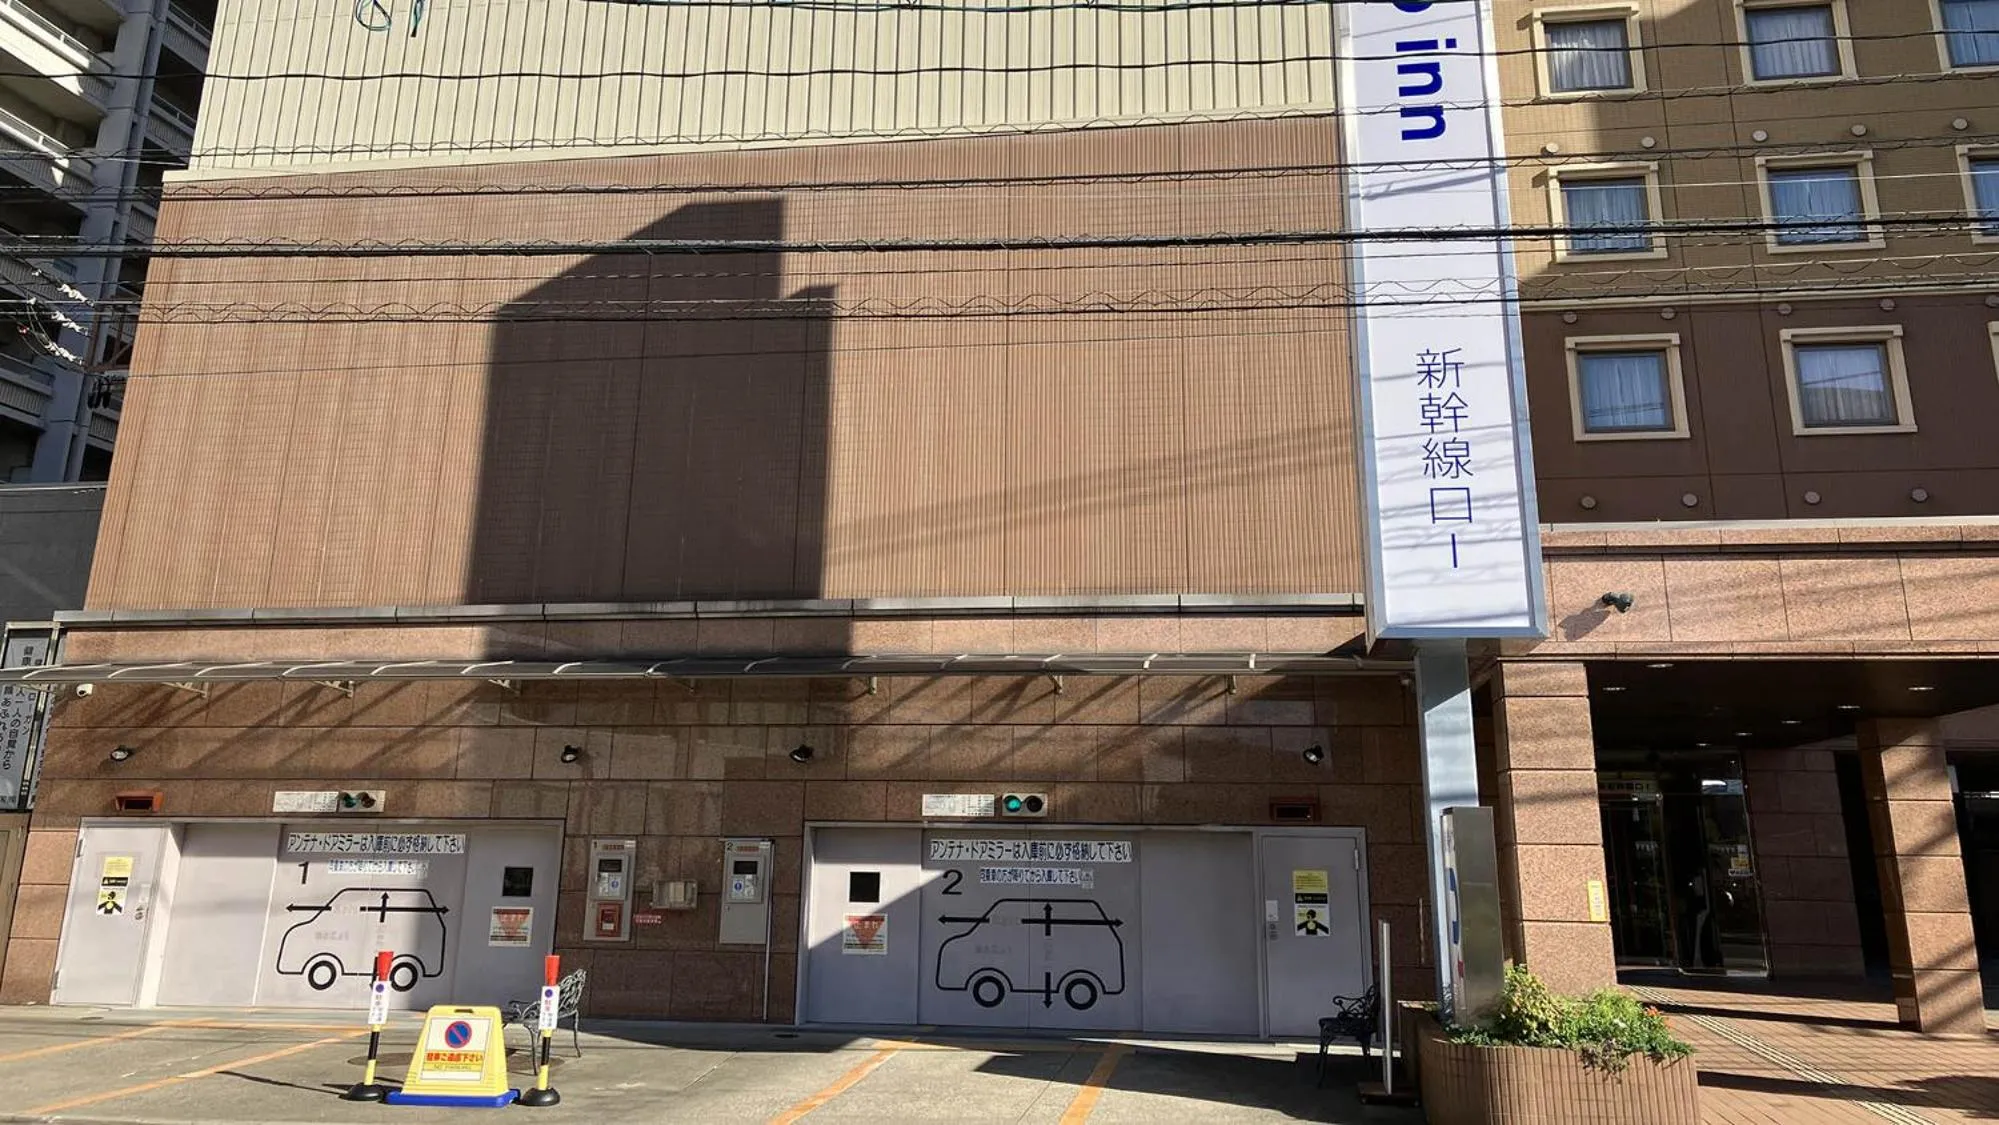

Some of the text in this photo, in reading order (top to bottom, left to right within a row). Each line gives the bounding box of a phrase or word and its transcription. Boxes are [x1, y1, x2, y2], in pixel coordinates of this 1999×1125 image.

[1396, 38, 1457, 141] inn
[298, 861, 309, 885] 1
[942, 869, 963, 895] 2
